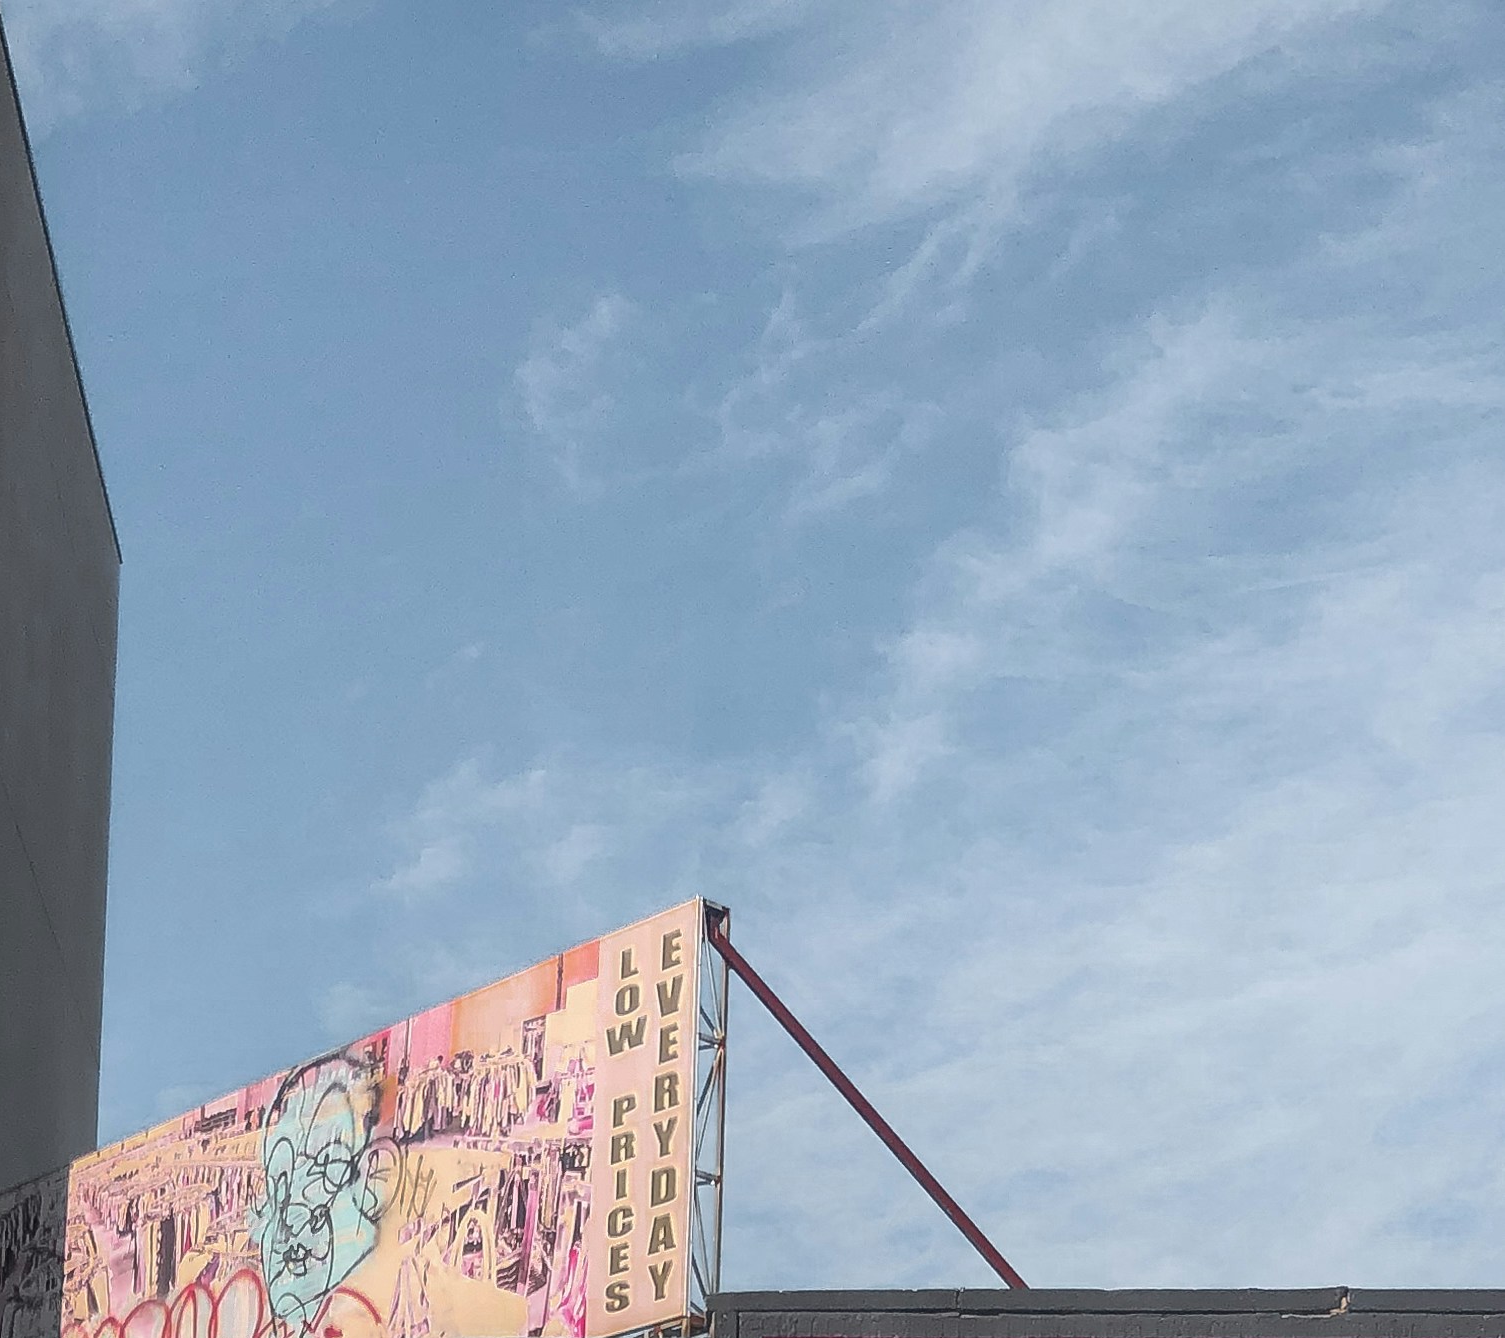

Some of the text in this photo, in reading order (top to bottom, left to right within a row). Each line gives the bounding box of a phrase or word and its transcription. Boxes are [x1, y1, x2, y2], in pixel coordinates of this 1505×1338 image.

[604, 947, 648, 1314] LOW PRICES
[645, 928, 684, 1303] EVERYDAY
